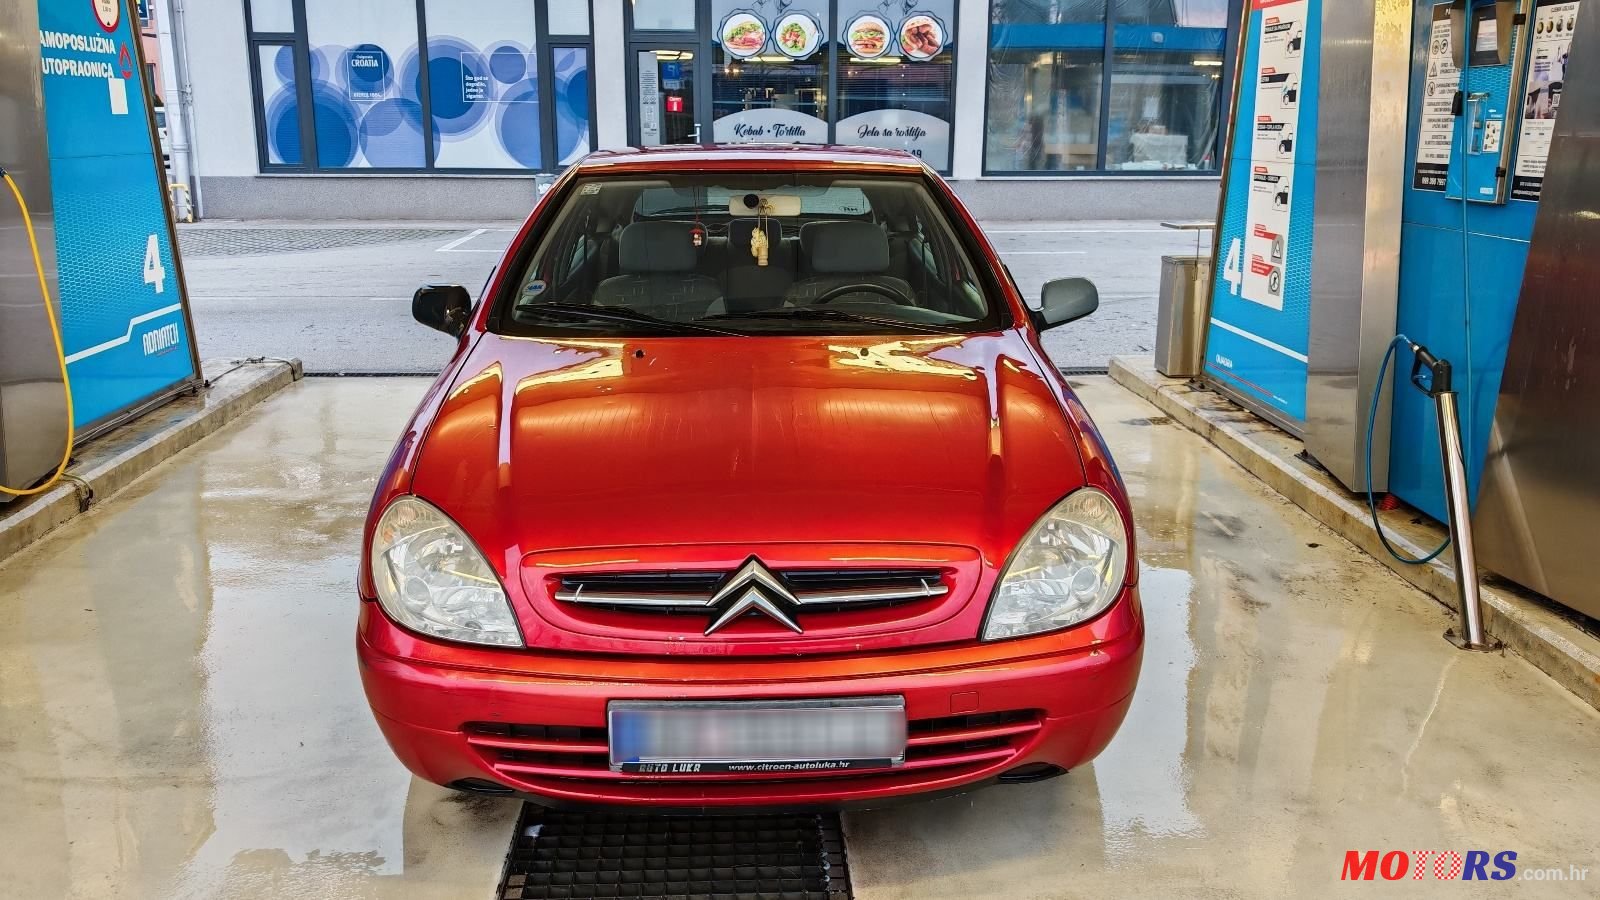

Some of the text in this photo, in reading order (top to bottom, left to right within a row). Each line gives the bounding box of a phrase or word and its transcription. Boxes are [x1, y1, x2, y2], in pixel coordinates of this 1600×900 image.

[351, 59, 379, 67] CROATIA
[733, 123, 806, 138] Kebab Tortilla
[857, 124, 926, 141] Jela sa roštilja
[144, 233, 165, 294] 4
[1223, 238, 1241, 295] 4
[639, 760, 851, 772] AUTO LUKA www.citroen-autoluka.hr
